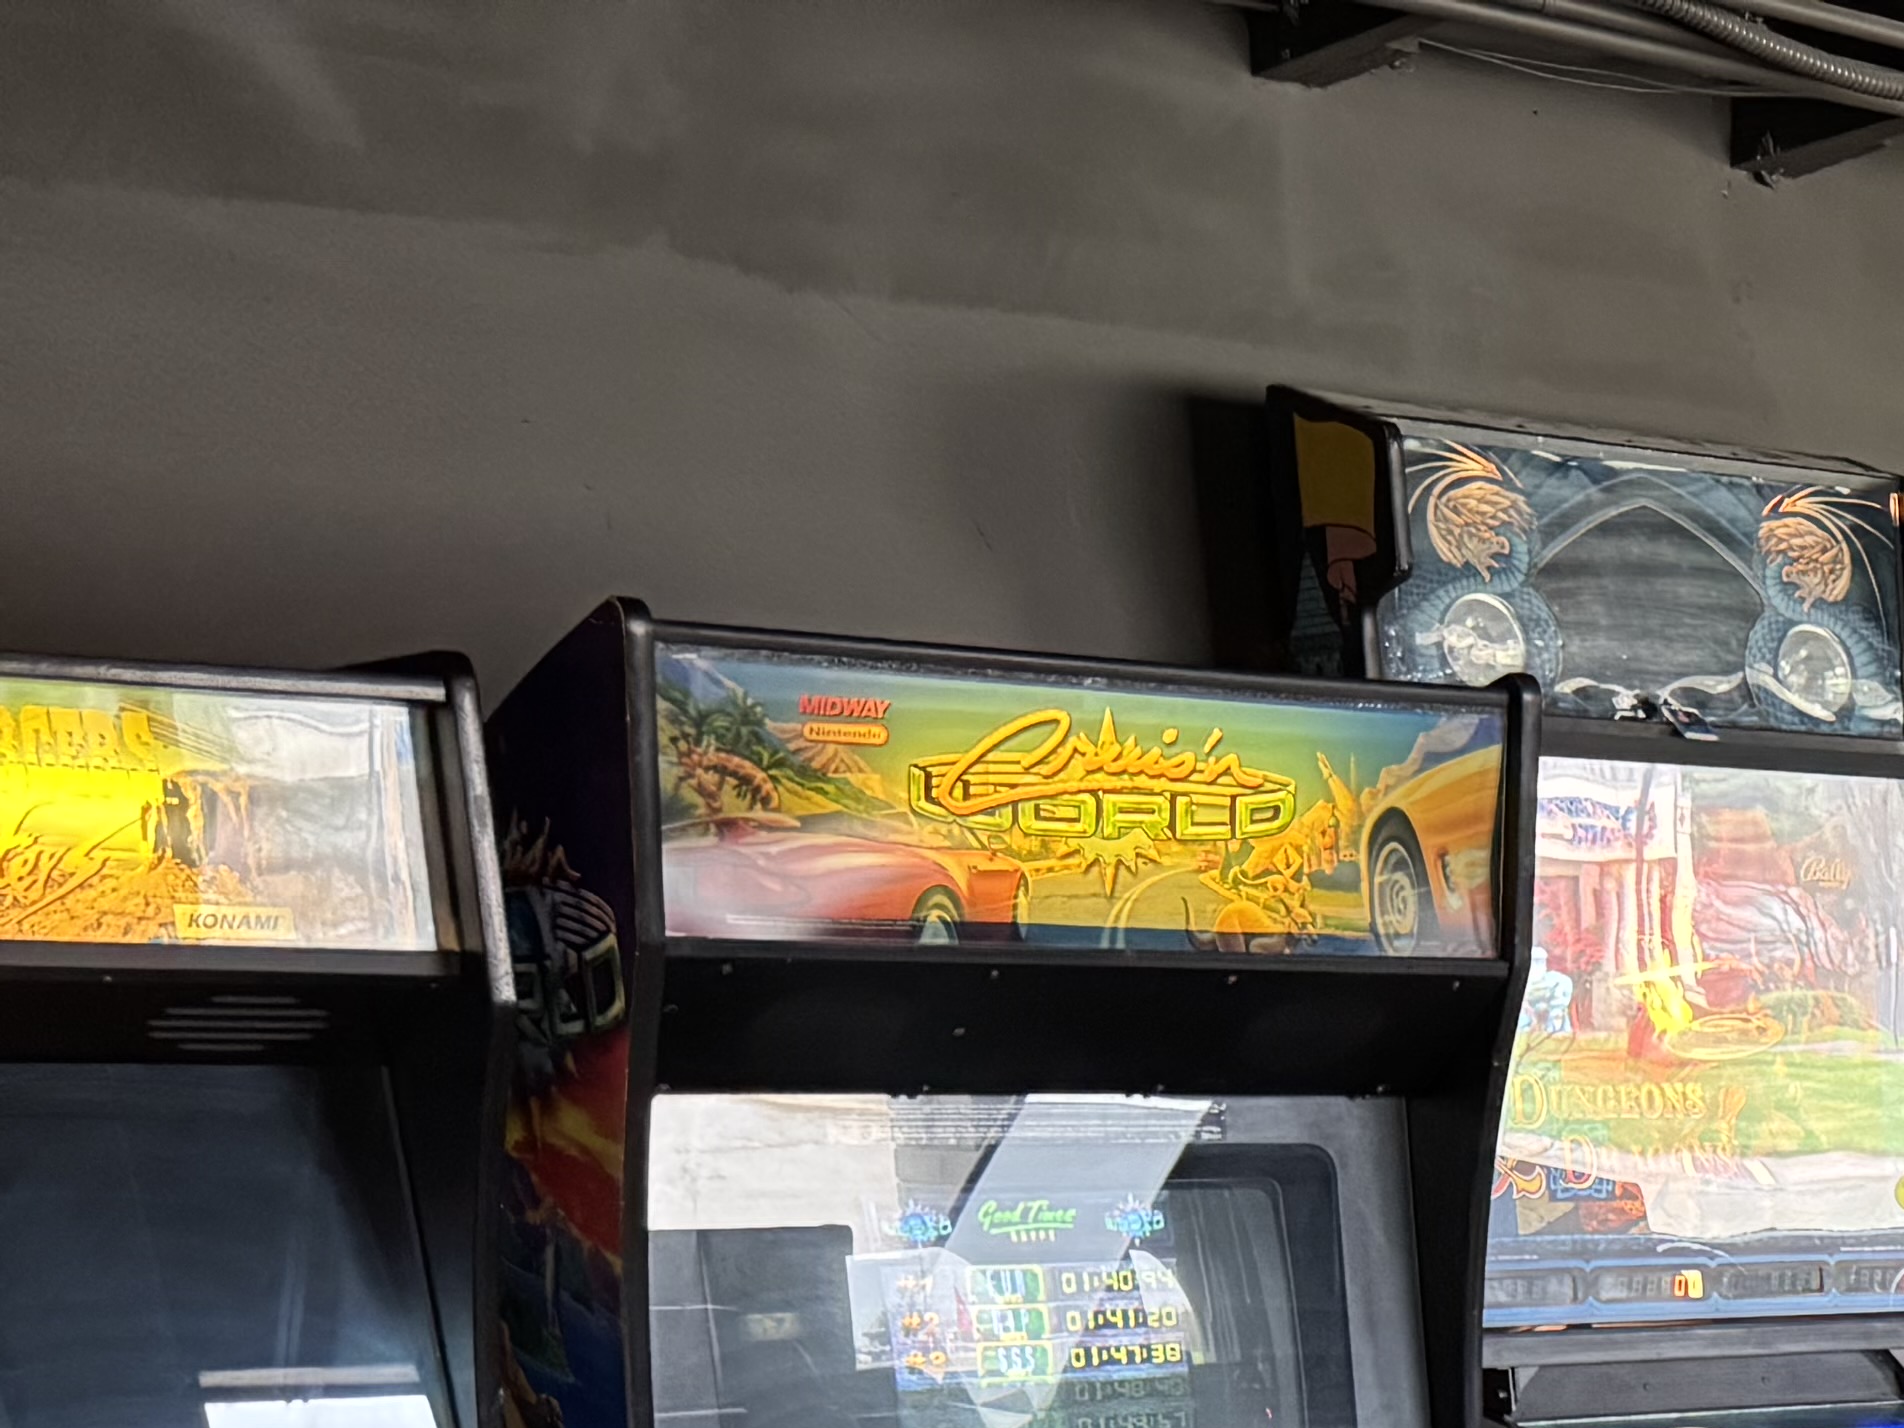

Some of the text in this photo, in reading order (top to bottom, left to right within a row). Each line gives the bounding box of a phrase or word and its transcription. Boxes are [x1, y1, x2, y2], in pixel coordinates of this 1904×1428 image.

[799, 694, 891, 719] MIDWAY
[807, 724, 882, 741] Nintendo
[909, 763, 1297, 840] WORLD
[1800, 855, 1851, 890] Bally
[187, 913, 279, 931] KONAMI
[1066, 1306, 1178, 1332] 01:41:20
[1071, 1343, 1182, 1369] 01:47:38
